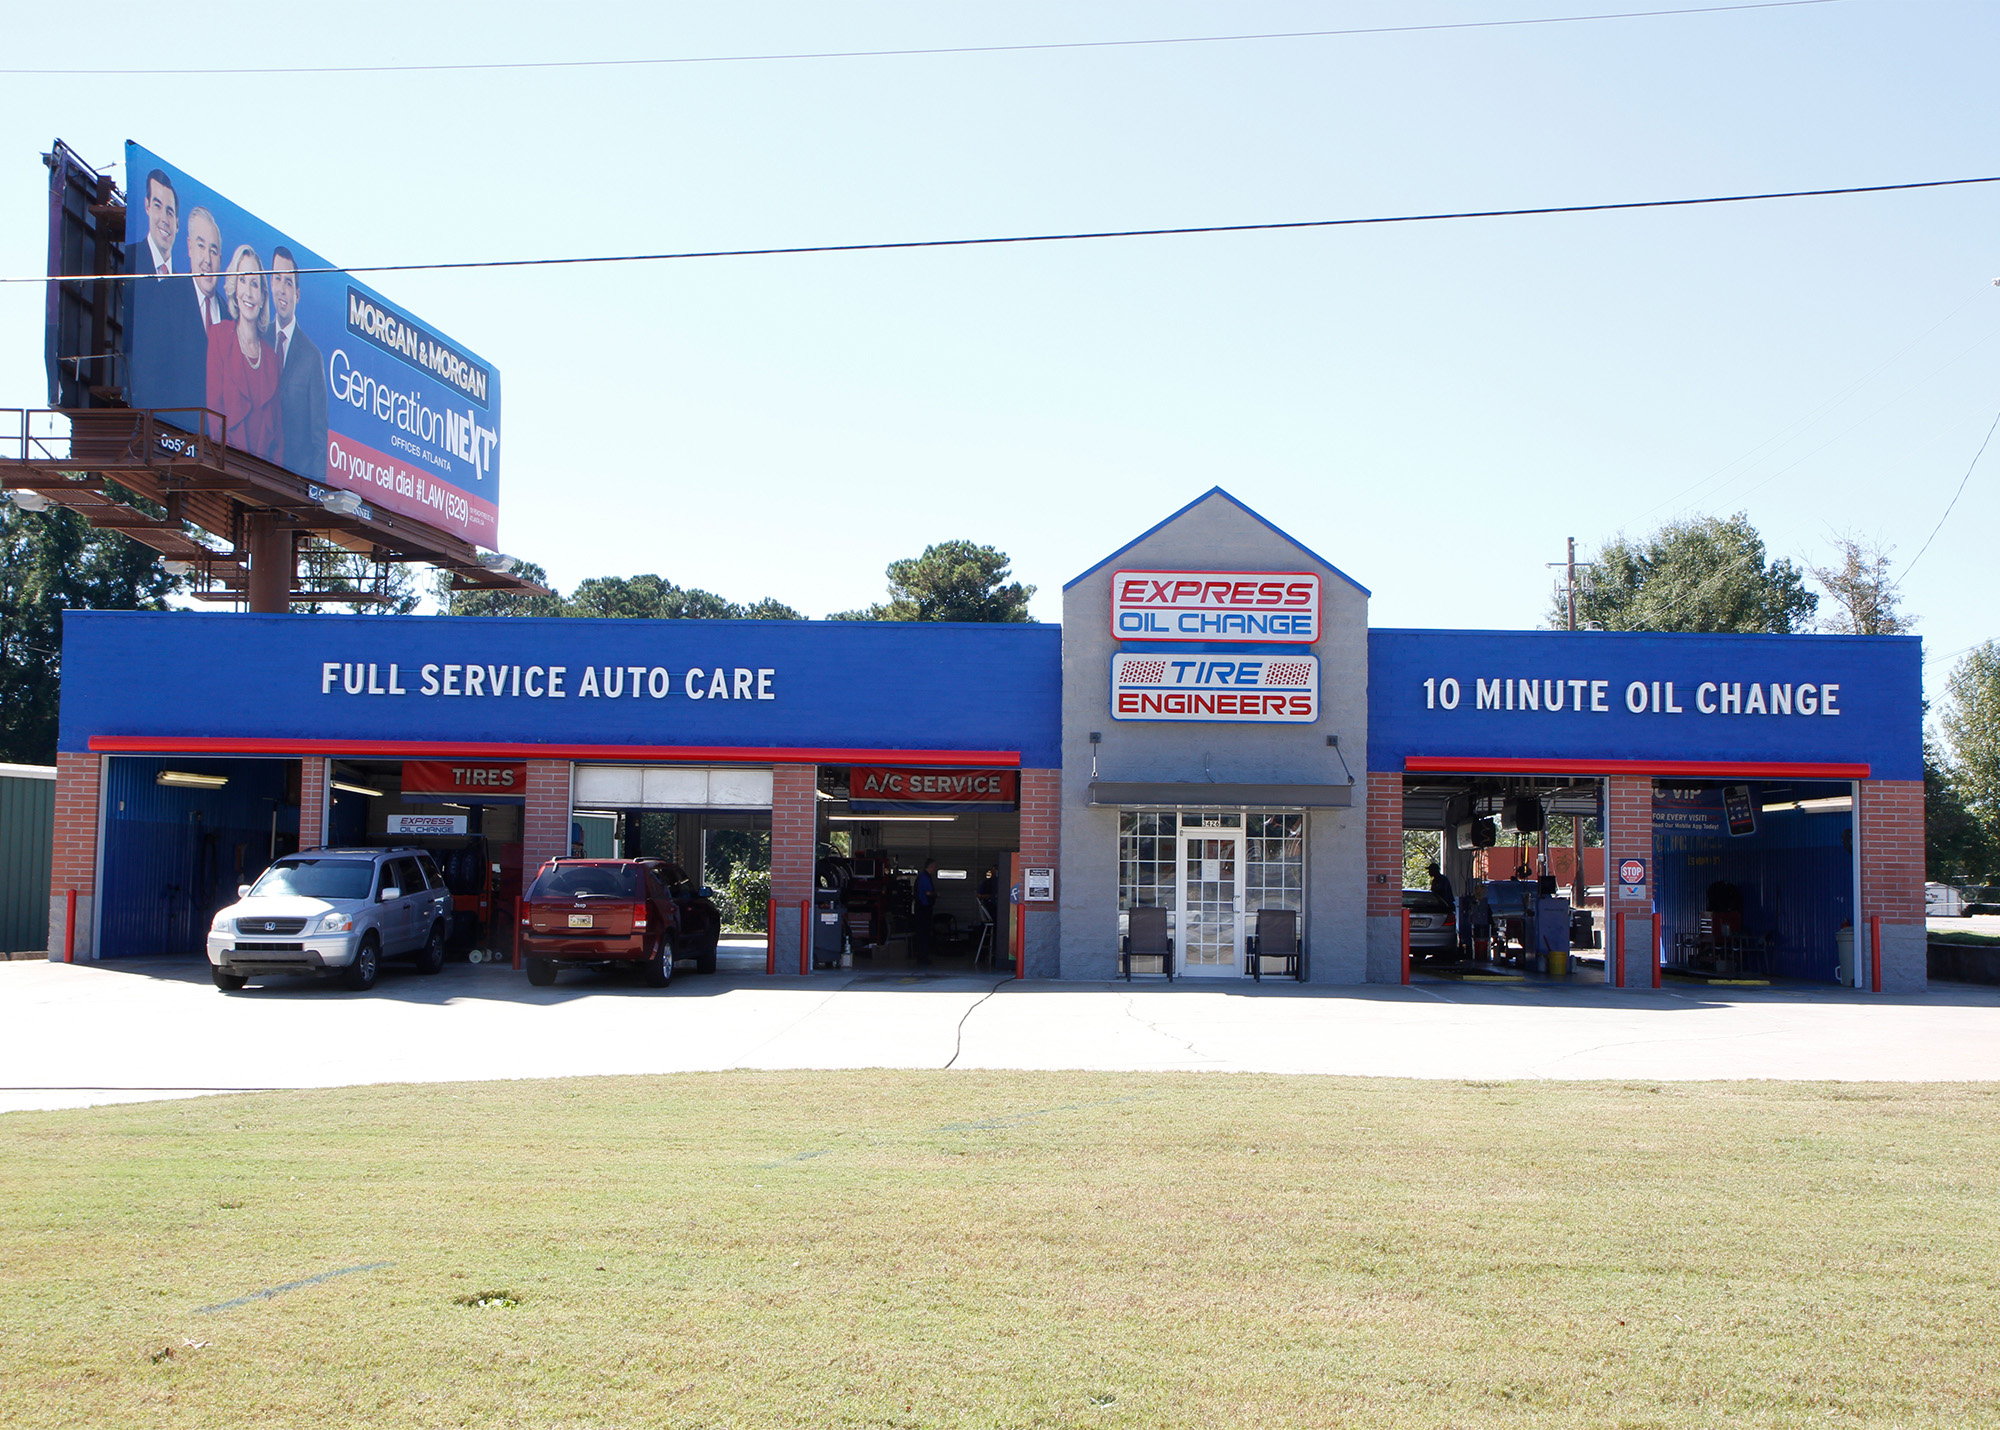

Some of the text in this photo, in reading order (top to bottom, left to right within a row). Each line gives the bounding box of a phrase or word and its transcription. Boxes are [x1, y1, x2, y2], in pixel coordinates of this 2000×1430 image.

[350, 294, 486, 401] MORGAN & MORGAN
[330, 349, 498, 481] Generation NEXT
[391, 435, 452, 472] OFFICES ATLANTA
[329, 441, 347, 471] On
[349, 454, 375, 482] your
[376, 465, 395, 491] cell
[396, 470, 414, 498] dial
[416, 478, 446, 511] #LAW
[445, 492, 469, 528] (529)
[1120, 580, 1314, 605] EXPRESS
[1119, 612, 1312, 635] OIL CHANGE
[322, 662, 776, 700] FULL SERVICE AUTO CARE
[1171, 661, 1263, 685] TIRE
[1118, 693, 1312, 716] ENGINEERS
[1423, 677, 1841, 716] 10 MINUTE OIL CHANGE
[452, 767, 515, 786] TIRES
[864, 772, 1002, 794] A/C SERVICE
[400, 817, 455, 825] EXPRESS
[1667, 813, 1688, 821] EVERY
[1622, 866, 1642, 876] STOP
